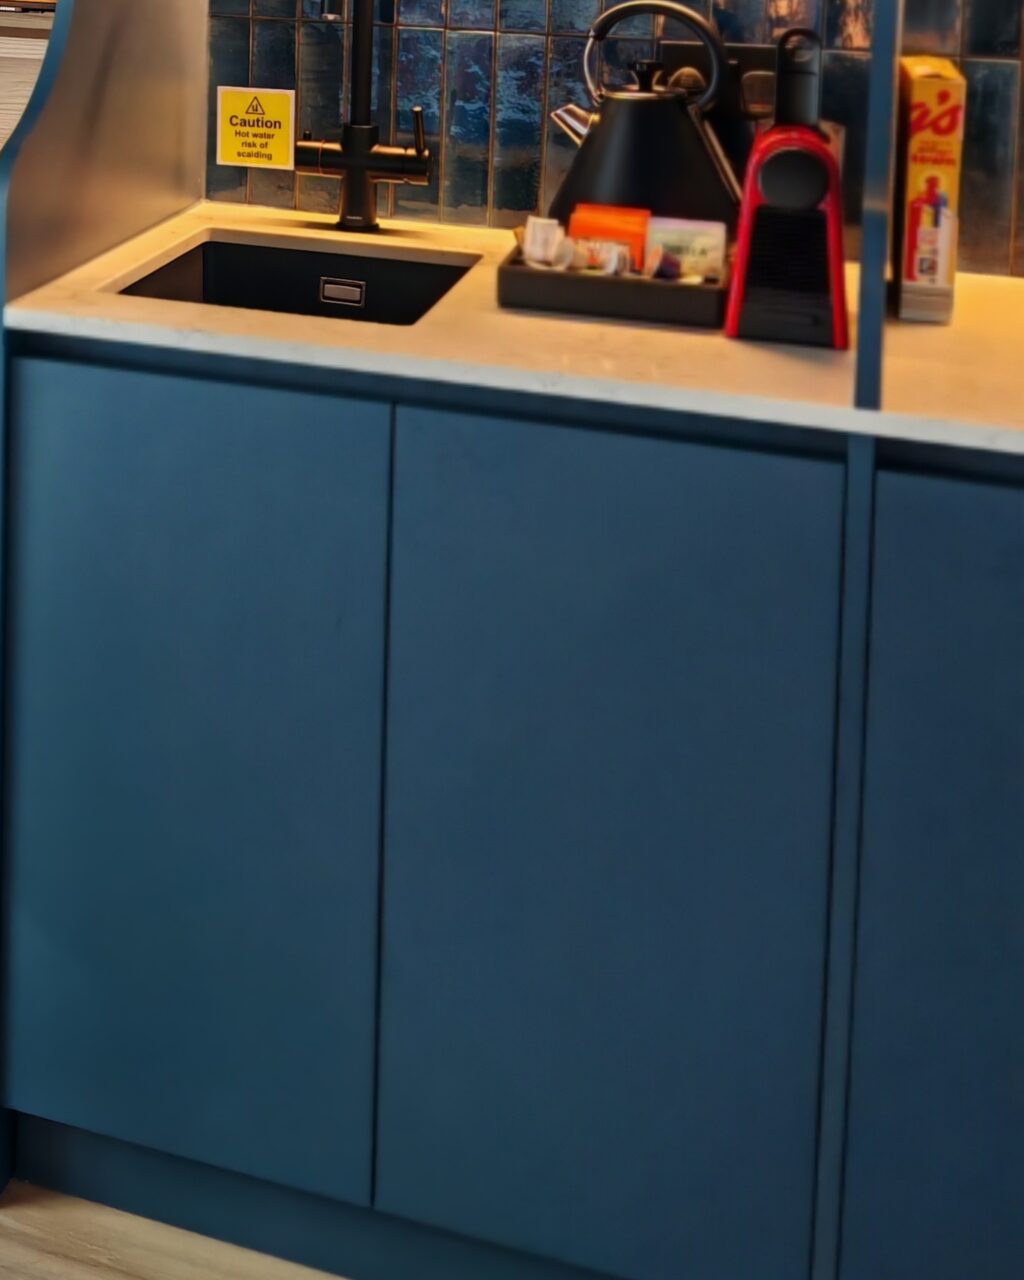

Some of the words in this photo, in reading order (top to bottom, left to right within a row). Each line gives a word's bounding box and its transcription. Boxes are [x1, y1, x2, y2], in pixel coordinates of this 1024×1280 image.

[229, 114, 282, 129] Caution
[235, 130, 250, 138] Hot
[251, 131, 275, 139] water
[241, 140, 258, 148] risk
[259, 141, 269, 149] of
[237, 151, 273, 161] scalding
